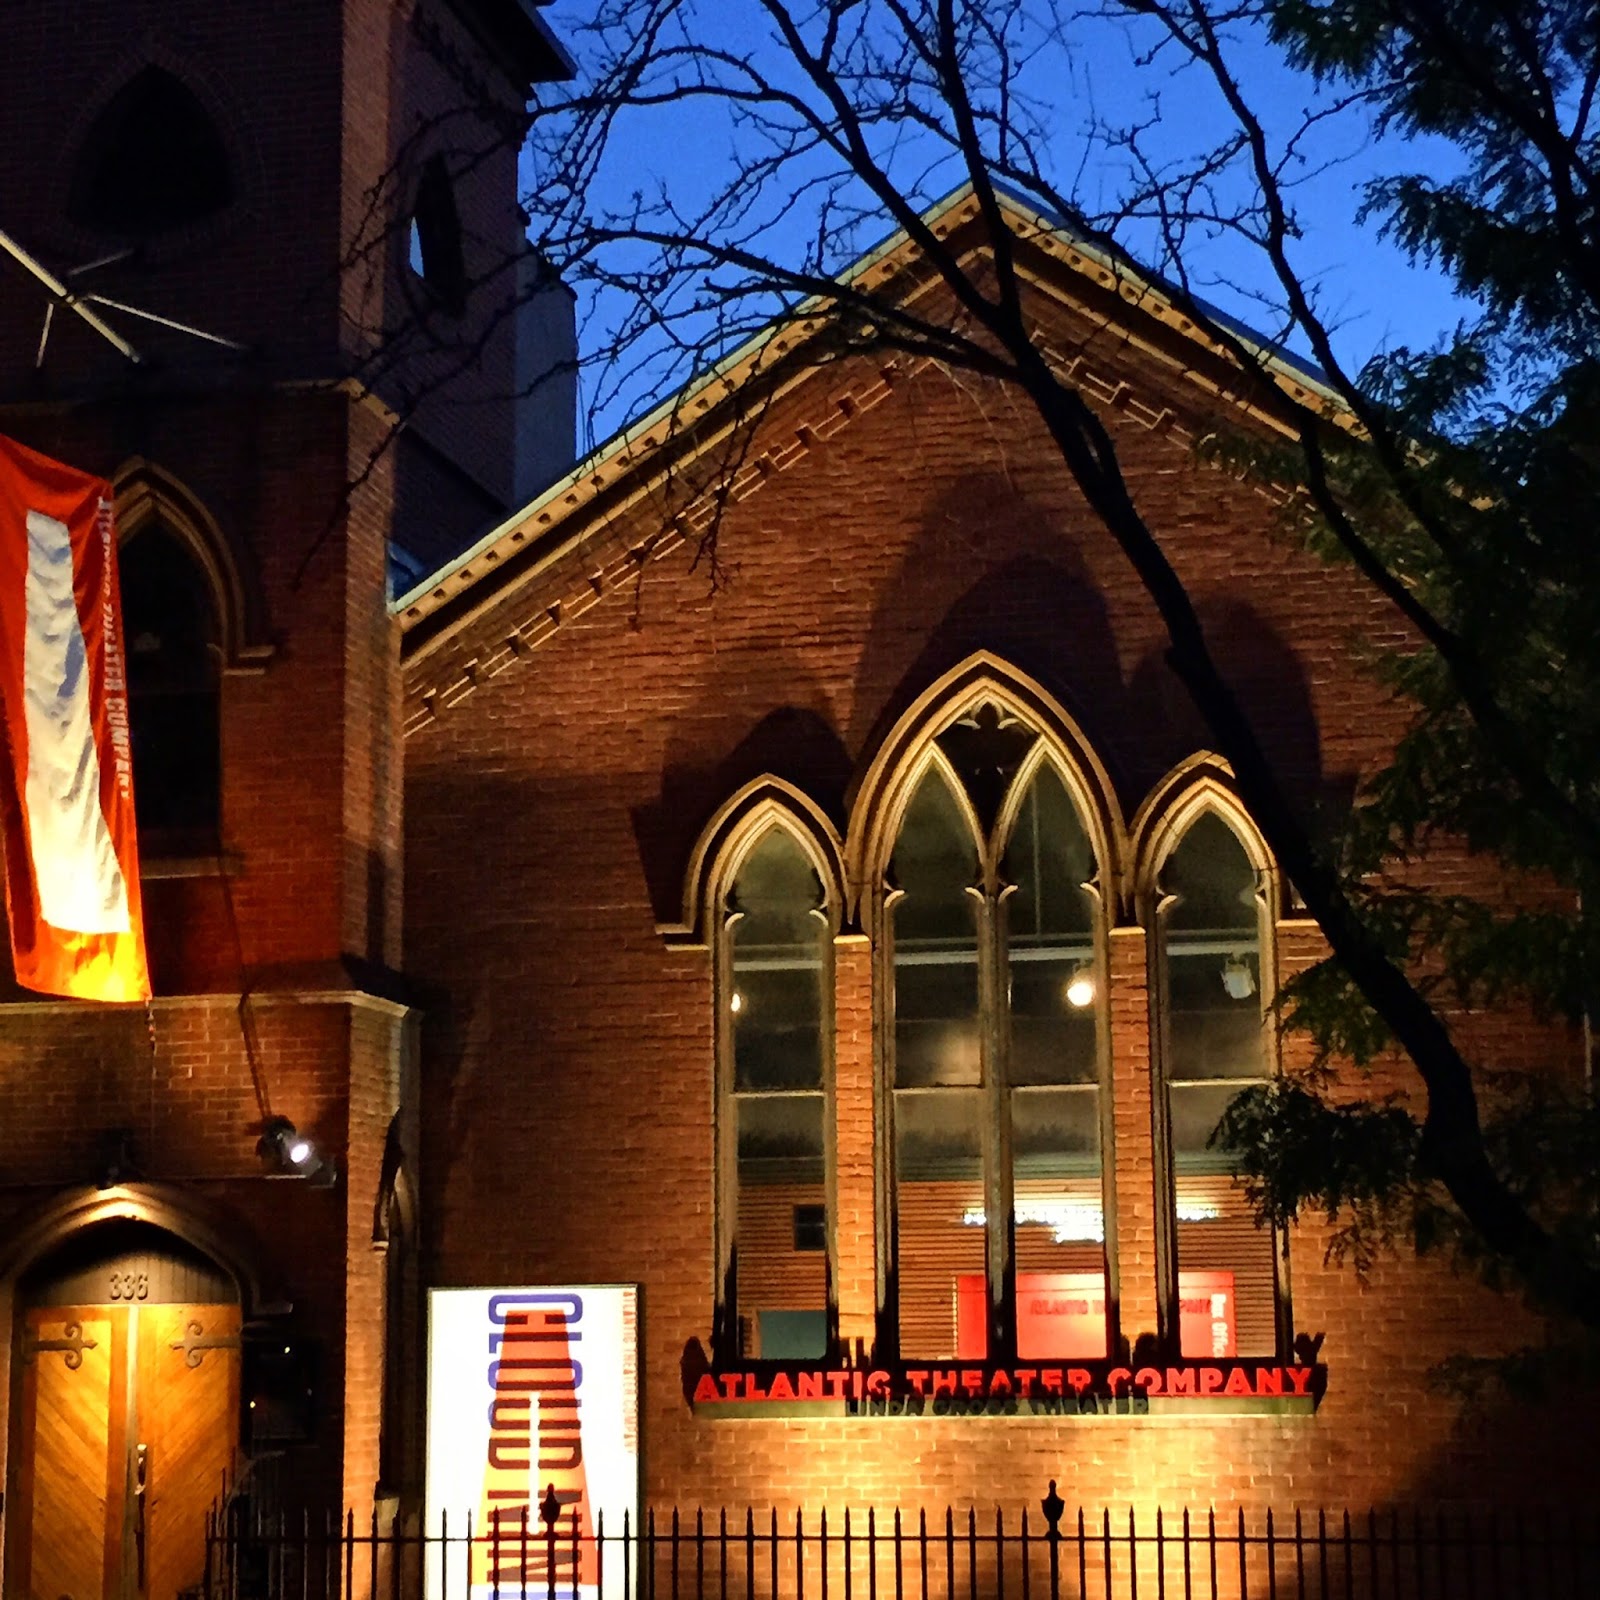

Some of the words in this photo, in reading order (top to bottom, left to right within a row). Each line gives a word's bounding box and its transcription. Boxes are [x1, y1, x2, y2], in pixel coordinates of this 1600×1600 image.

[488, 1294, 583, 1470] CLOUD
[694, 1371, 891, 1400] ATLANTIC
[906, 1369, 1092, 1399] THEATER
[1107, 1367, 1313, 1397] COMPANY
[845, 1396, 924, 1416] LINDA
